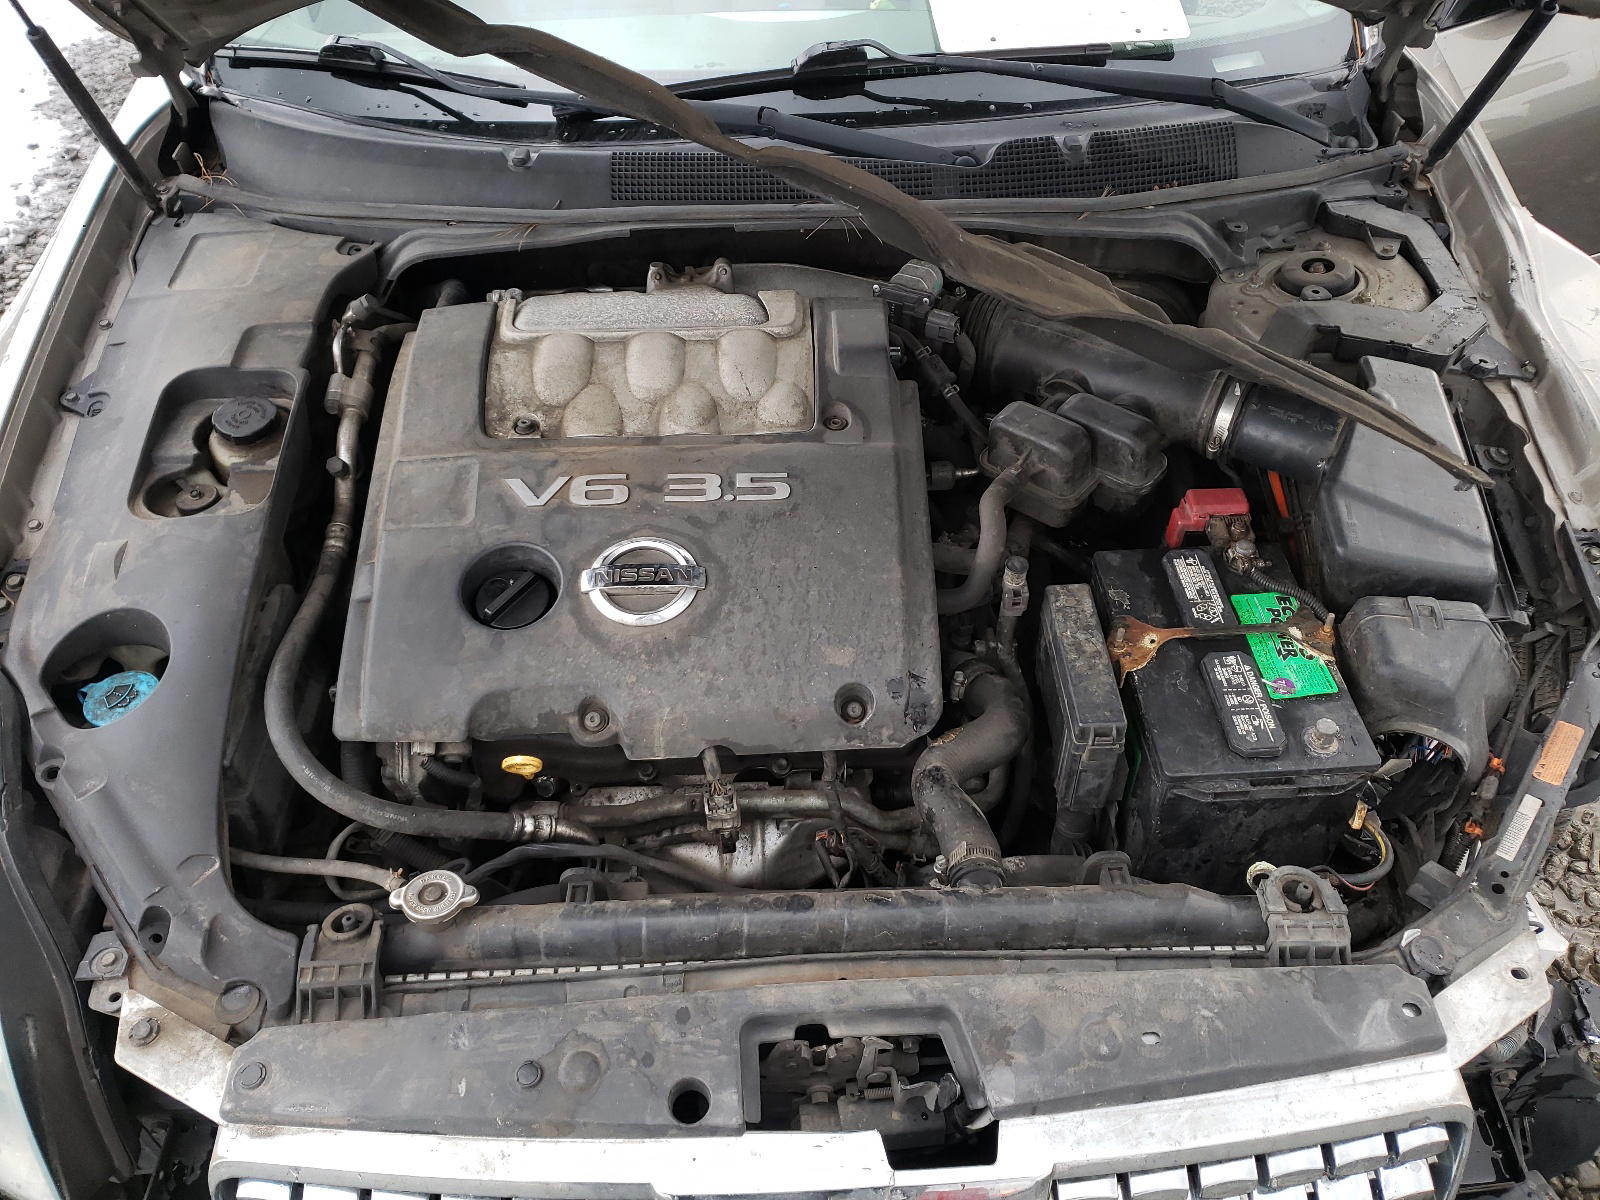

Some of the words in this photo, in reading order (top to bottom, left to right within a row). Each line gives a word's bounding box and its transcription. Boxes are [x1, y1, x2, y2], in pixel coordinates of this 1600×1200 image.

[504, 473, 629, 507] V6
[664, 473, 792, 502] 3.5
[594, 567, 693, 585] NISSAN
[1245, 672, 1262, 697] DANGER
[1259, 703, 1275, 728] POISON
